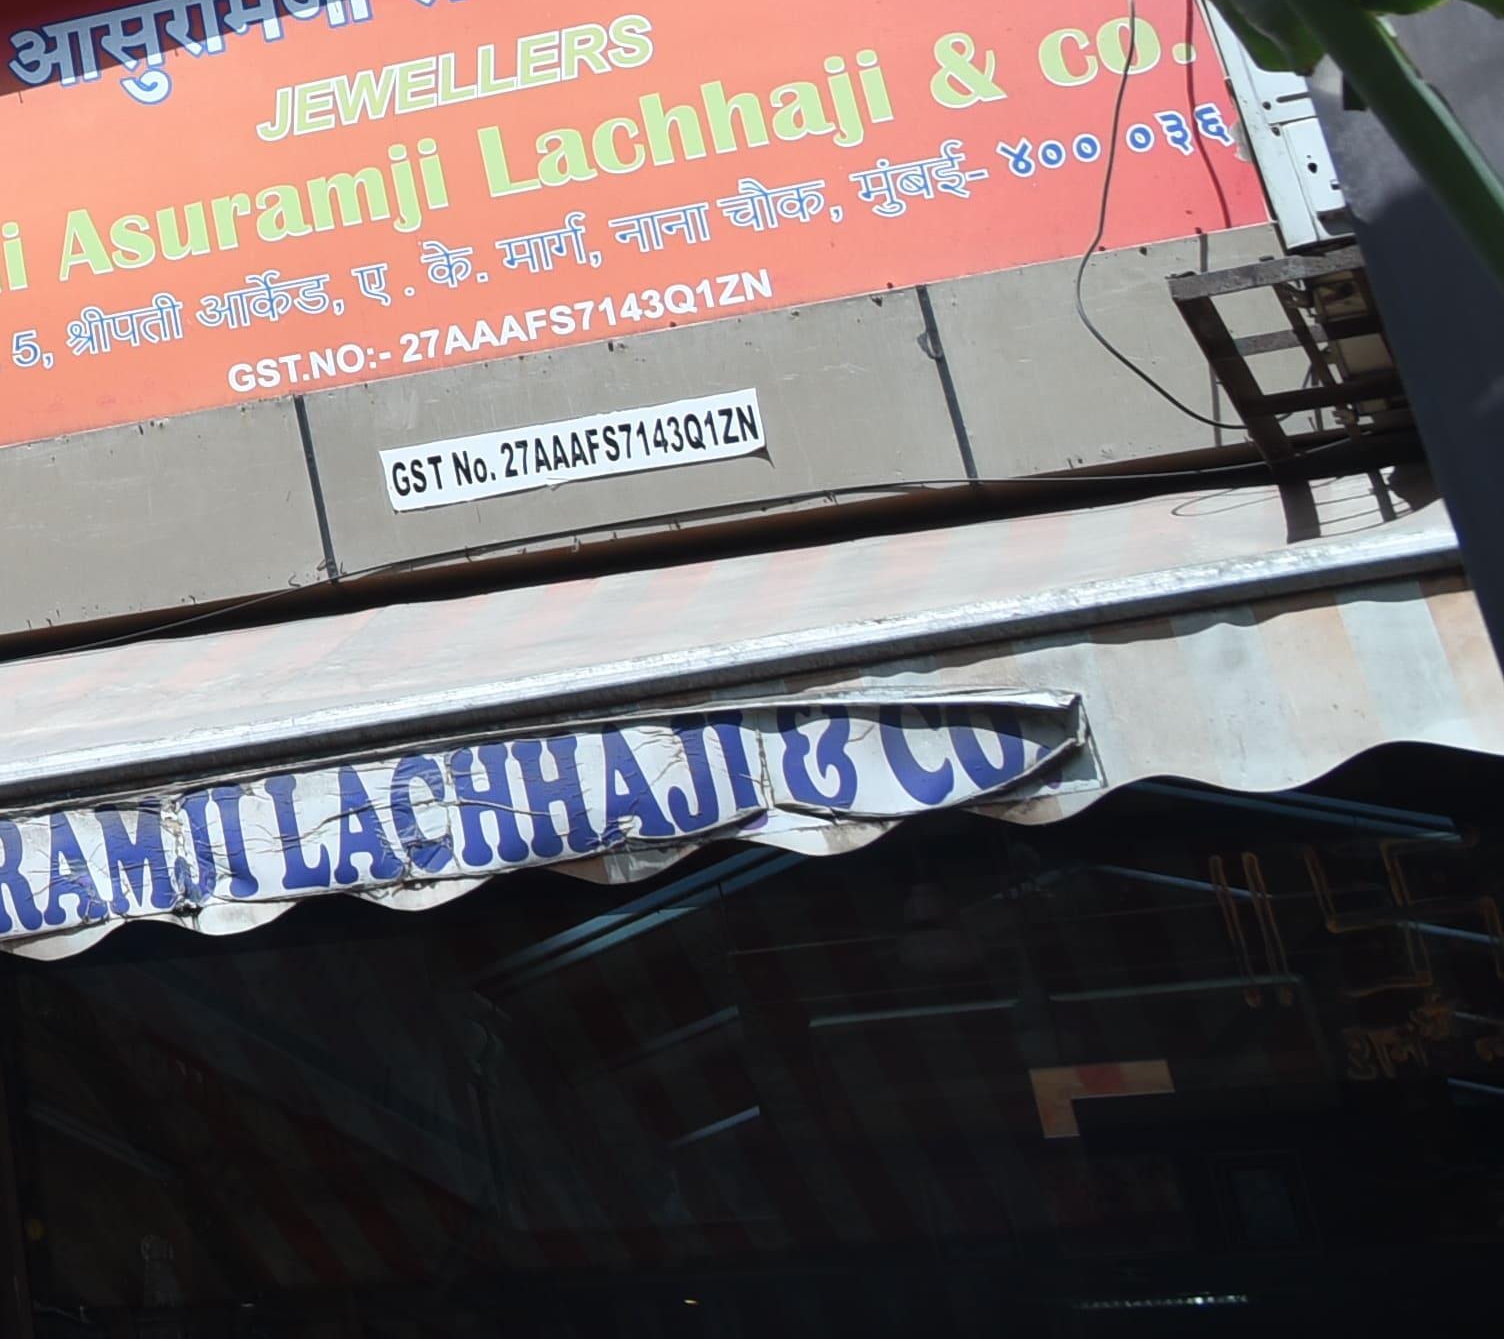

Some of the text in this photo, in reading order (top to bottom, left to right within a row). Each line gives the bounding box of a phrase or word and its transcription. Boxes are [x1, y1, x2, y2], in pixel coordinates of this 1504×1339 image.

[256, 13, 655, 142] JEWELLERS
[57, 137, 451, 283] Asuramji
[476, 46, 894, 198] Lachhaji
[929, 30, 1007, 108] &
[66, 297, 184, 358] श्रीपती
[609, 205, 712, 254] नाना
[392, 404, 759, 497] GST No. 27AAAFS7143Q1ZN
[278, 709, 761, 892] LACHHAJI
[777, 705, 857, 810] &
